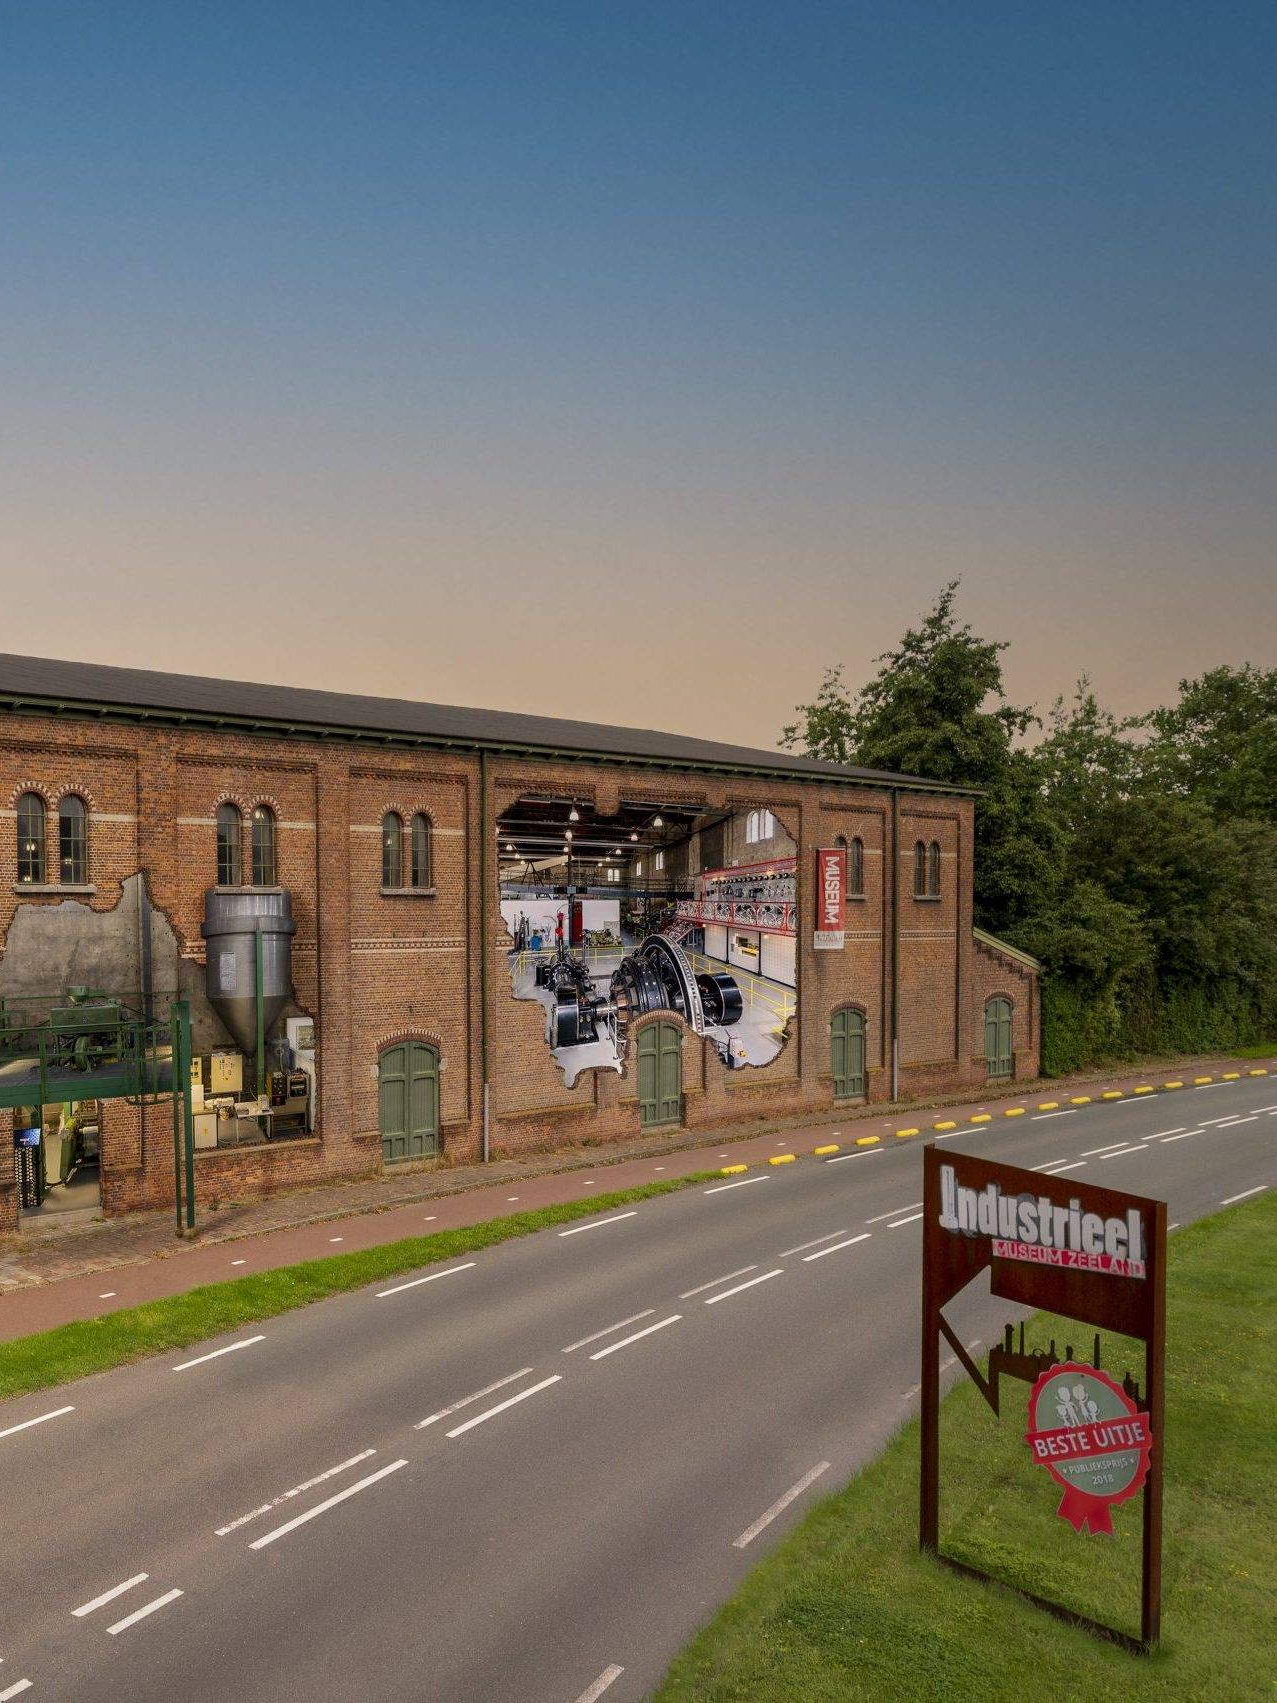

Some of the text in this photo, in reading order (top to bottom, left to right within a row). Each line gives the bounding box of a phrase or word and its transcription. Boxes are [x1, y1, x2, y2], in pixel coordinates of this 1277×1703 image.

[824, 856, 841, 924] MUSEUM
[938, 1164, 1145, 1262] Industrieel
[993, 1240, 1146, 1279] MUSEUM ZEELAND
[1034, 1422, 1145, 1457] BESTE UITJE
[1069, 1457, 1128, 1474] PUBLIEKSPRIJS
[1092, 1474, 1114, 1485] 2018
